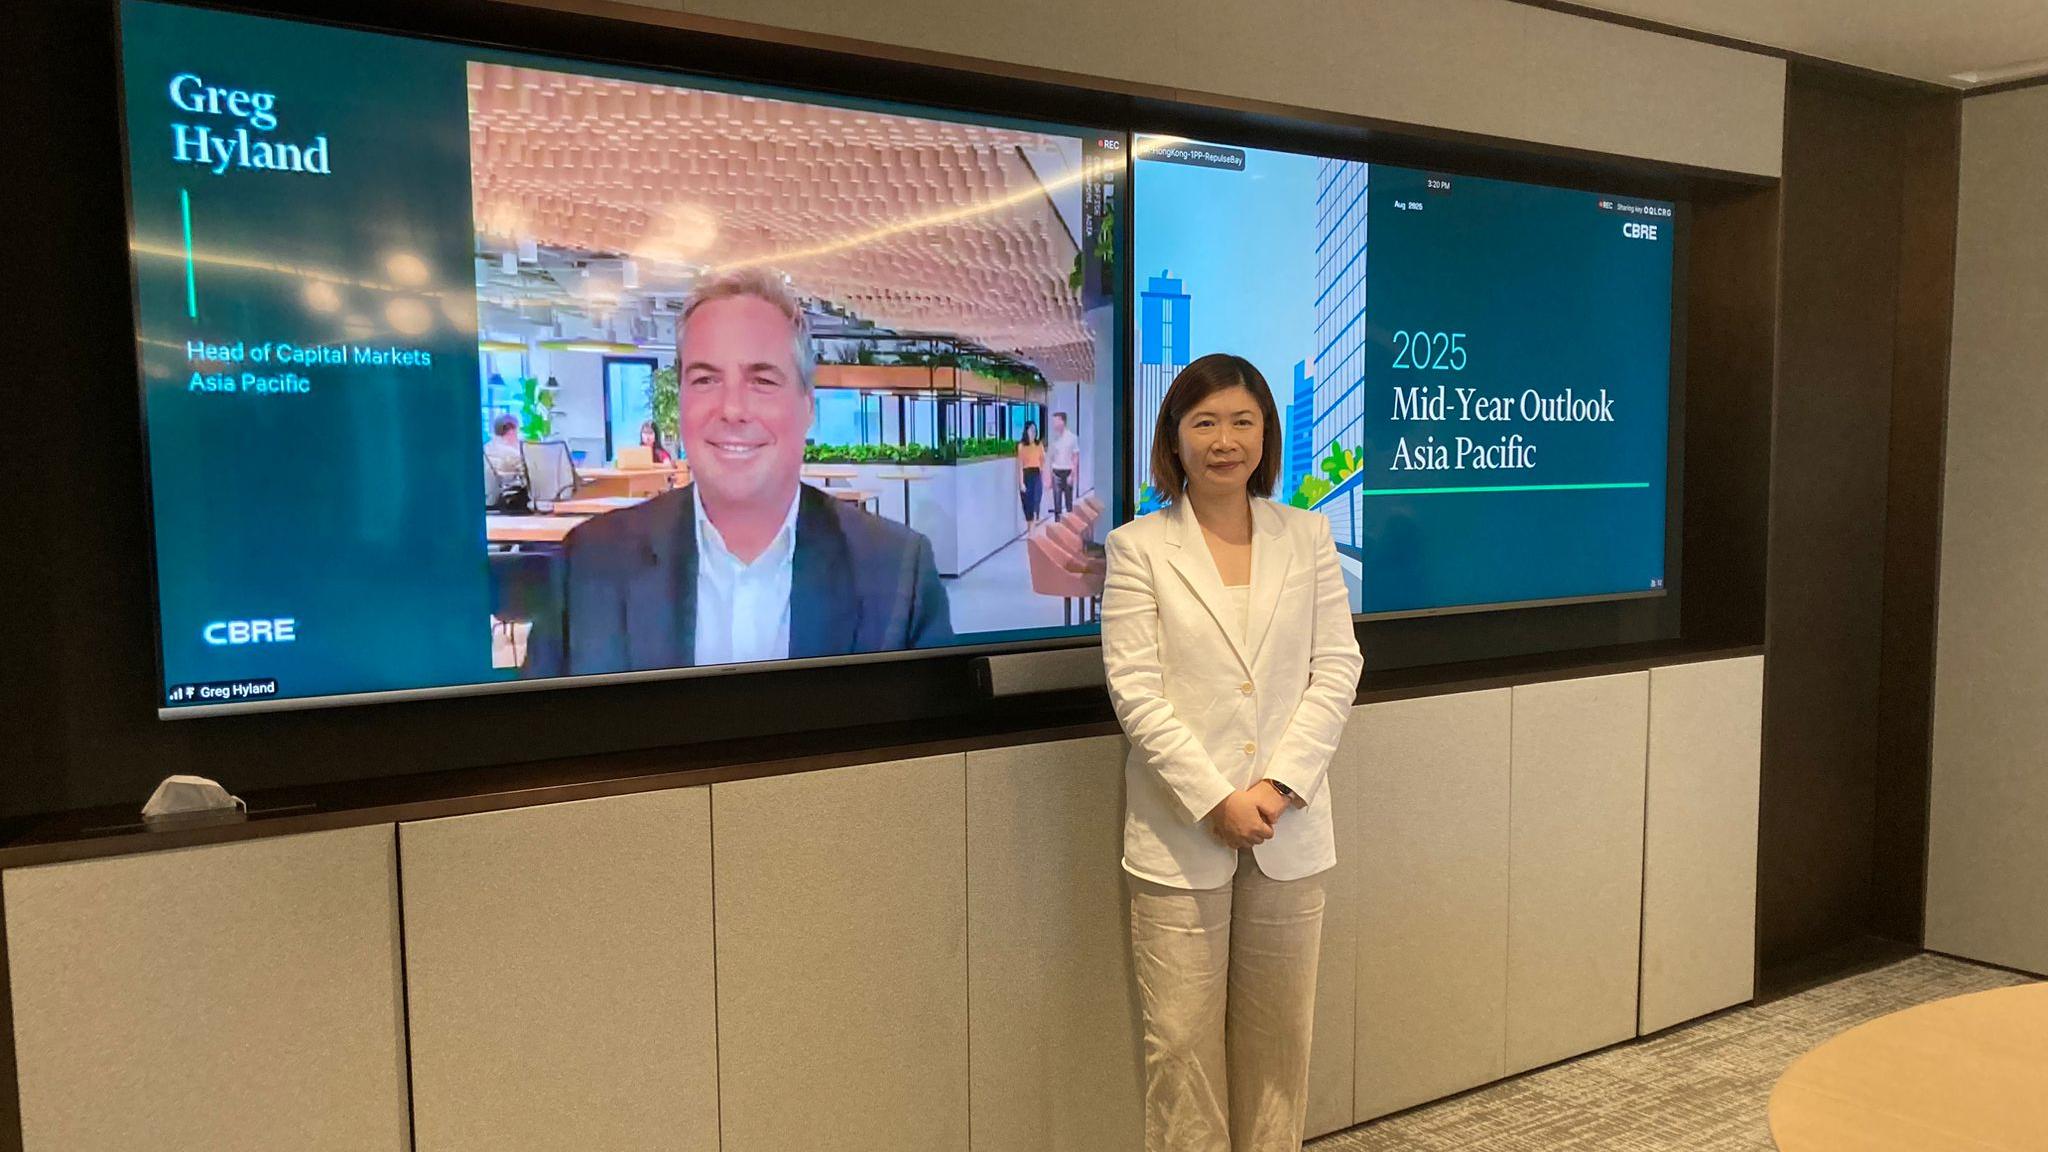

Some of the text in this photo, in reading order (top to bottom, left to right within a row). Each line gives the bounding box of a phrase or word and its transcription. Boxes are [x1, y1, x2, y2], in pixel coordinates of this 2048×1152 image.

[169, 73, 277, 129] Greg
[171, 124, 332, 174] Hyland
[1103, 139, 1120, 150] REC
[1441, 181, 1451, 190] PM
[1394, 200, 1406, 210] Aug
[1603, 201, 1613, 210] REC
[1617, 203, 1635, 214] Sharing
[1623, 222, 1657, 240] CBRE
[187, 340, 431, 367] Head of Capital Markets
[1392, 330, 1467, 370] 2025
[188, 371, 311, 393] Asia Pacific
[1391, 386, 1615, 422] Mid-Year Outlook
[1390, 434, 1536, 470] Asia Pacific
[203, 618, 296, 646] CBRE
[200, 681, 275, 699] Greg Hyland
